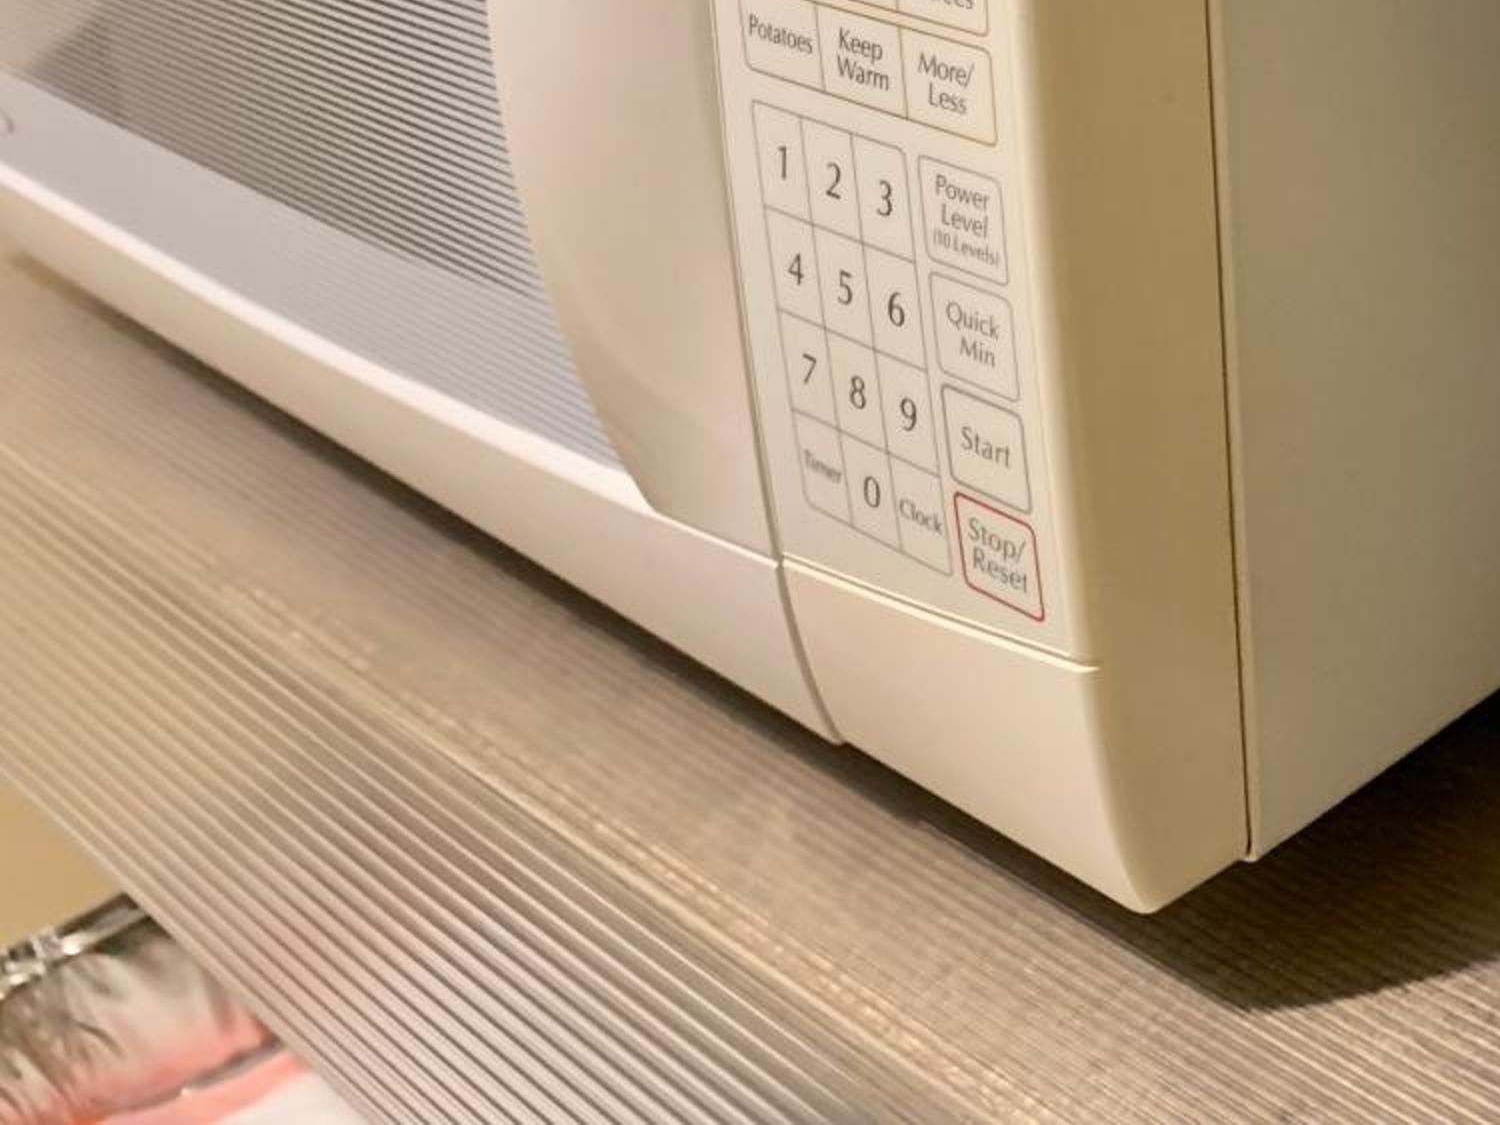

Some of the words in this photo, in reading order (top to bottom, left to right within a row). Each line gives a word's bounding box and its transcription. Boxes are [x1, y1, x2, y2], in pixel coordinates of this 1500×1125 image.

[748, 14, 813, 55] Potatoes
[838, 27, 883, 64] Keep
[837, 55, 889, 91] Warm
[917, 52, 975, 89] More/
[928, 84, 968, 115] Less
[777, 145, 788, 181] 1
[825, 161, 841, 200] 2
[875, 179, 893, 217] 3
[935, 174, 990, 210] Power
[941, 203, 988, 237] Level
[787, 253, 804, 286] 4
[837, 269, 853, 305] 5
[887, 291, 905, 327] 6
[946, 301, 999, 340] Quick
[802, 352, 817, 384] 7
[959, 336, 996, 368] Min
[849, 375, 867, 410] 8
[900, 397, 917, 431] 9
[960, 425, 1011, 469] Start
[863, 475, 881, 509] 0
[899, 498, 943, 536] Clock
[968, 517, 1026, 560] Stop/
[973, 547, 1028, 593] Reset
